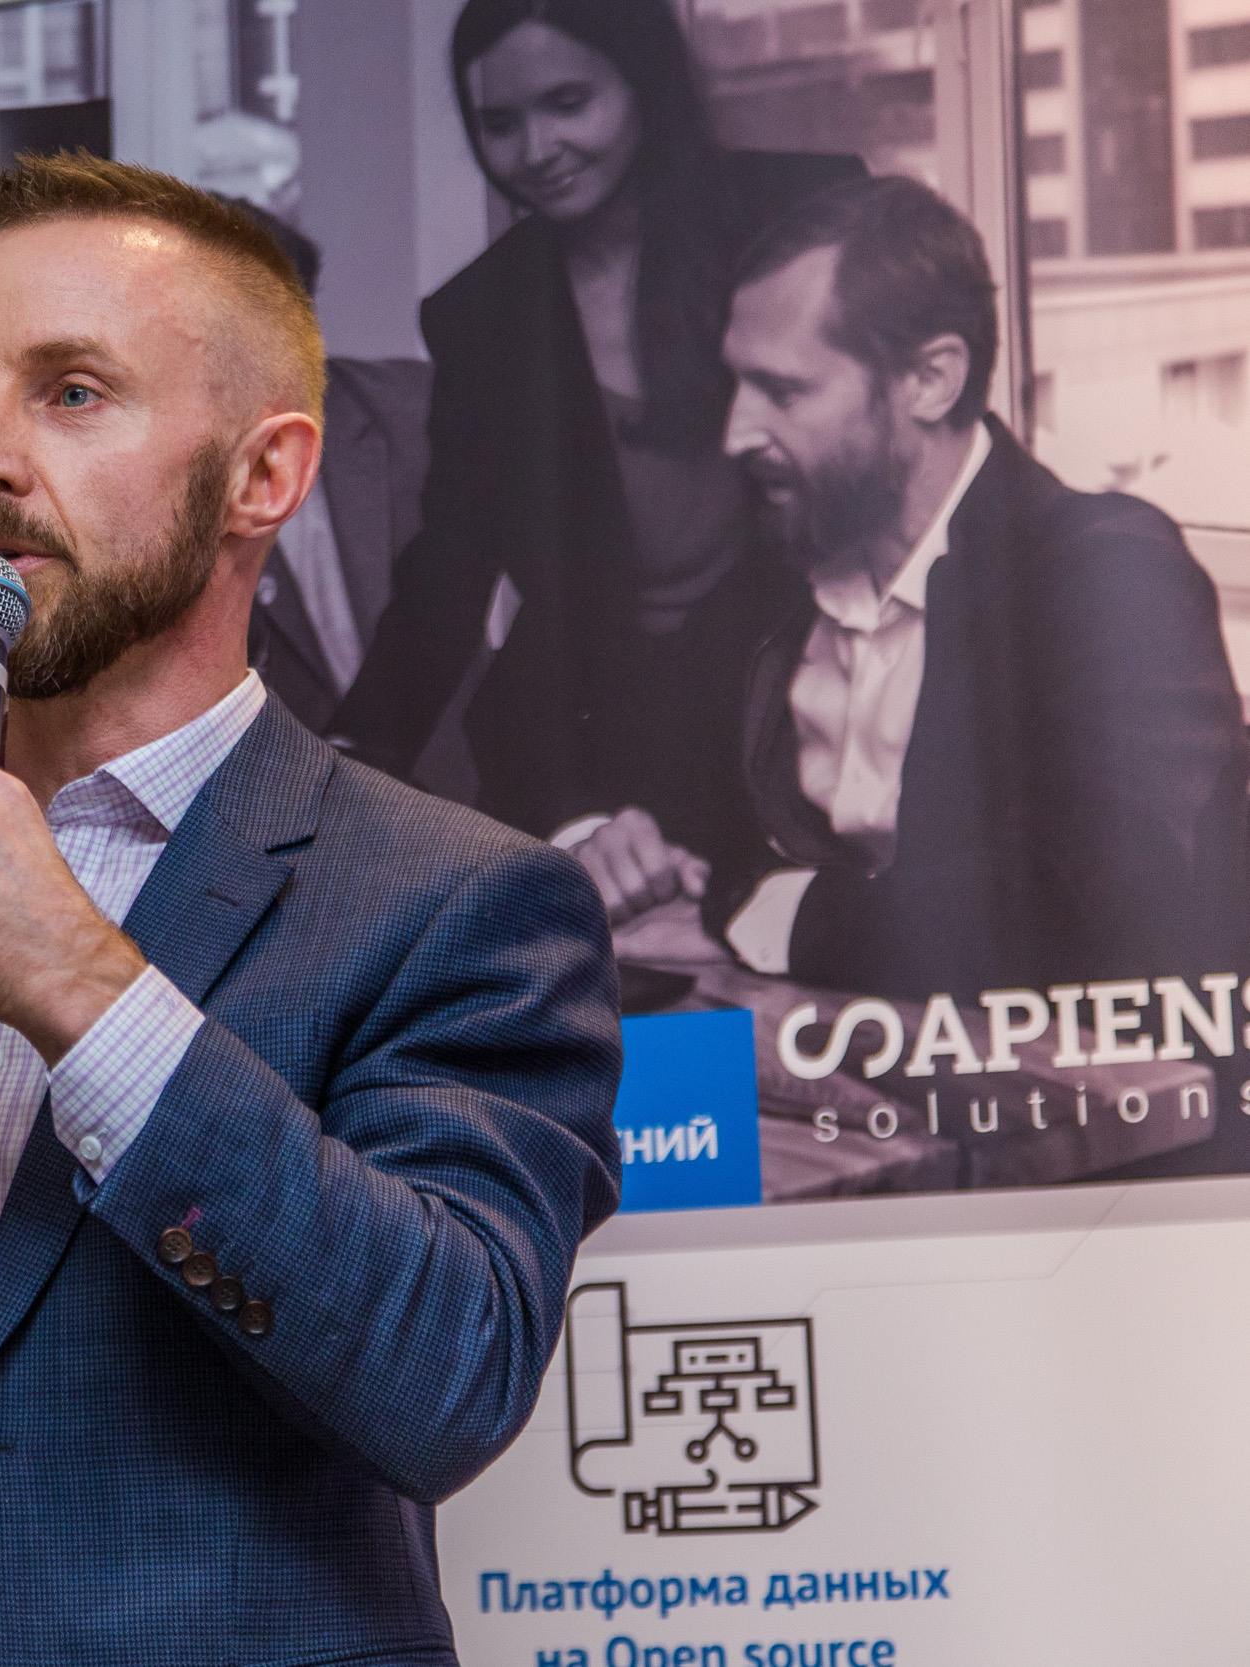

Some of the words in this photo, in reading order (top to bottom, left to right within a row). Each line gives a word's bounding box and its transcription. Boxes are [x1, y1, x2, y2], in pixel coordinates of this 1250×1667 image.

[775, 971, 1250, 1081] SAPIEN
[616, 1113, 719, 1165] НИЙ
[478, 1569, 749, 1621] Платформа
[761, 1567, 951, 1611] данных
[605, 1635, 727, 1667] Open
[744, 1639, 896, 1667] source
